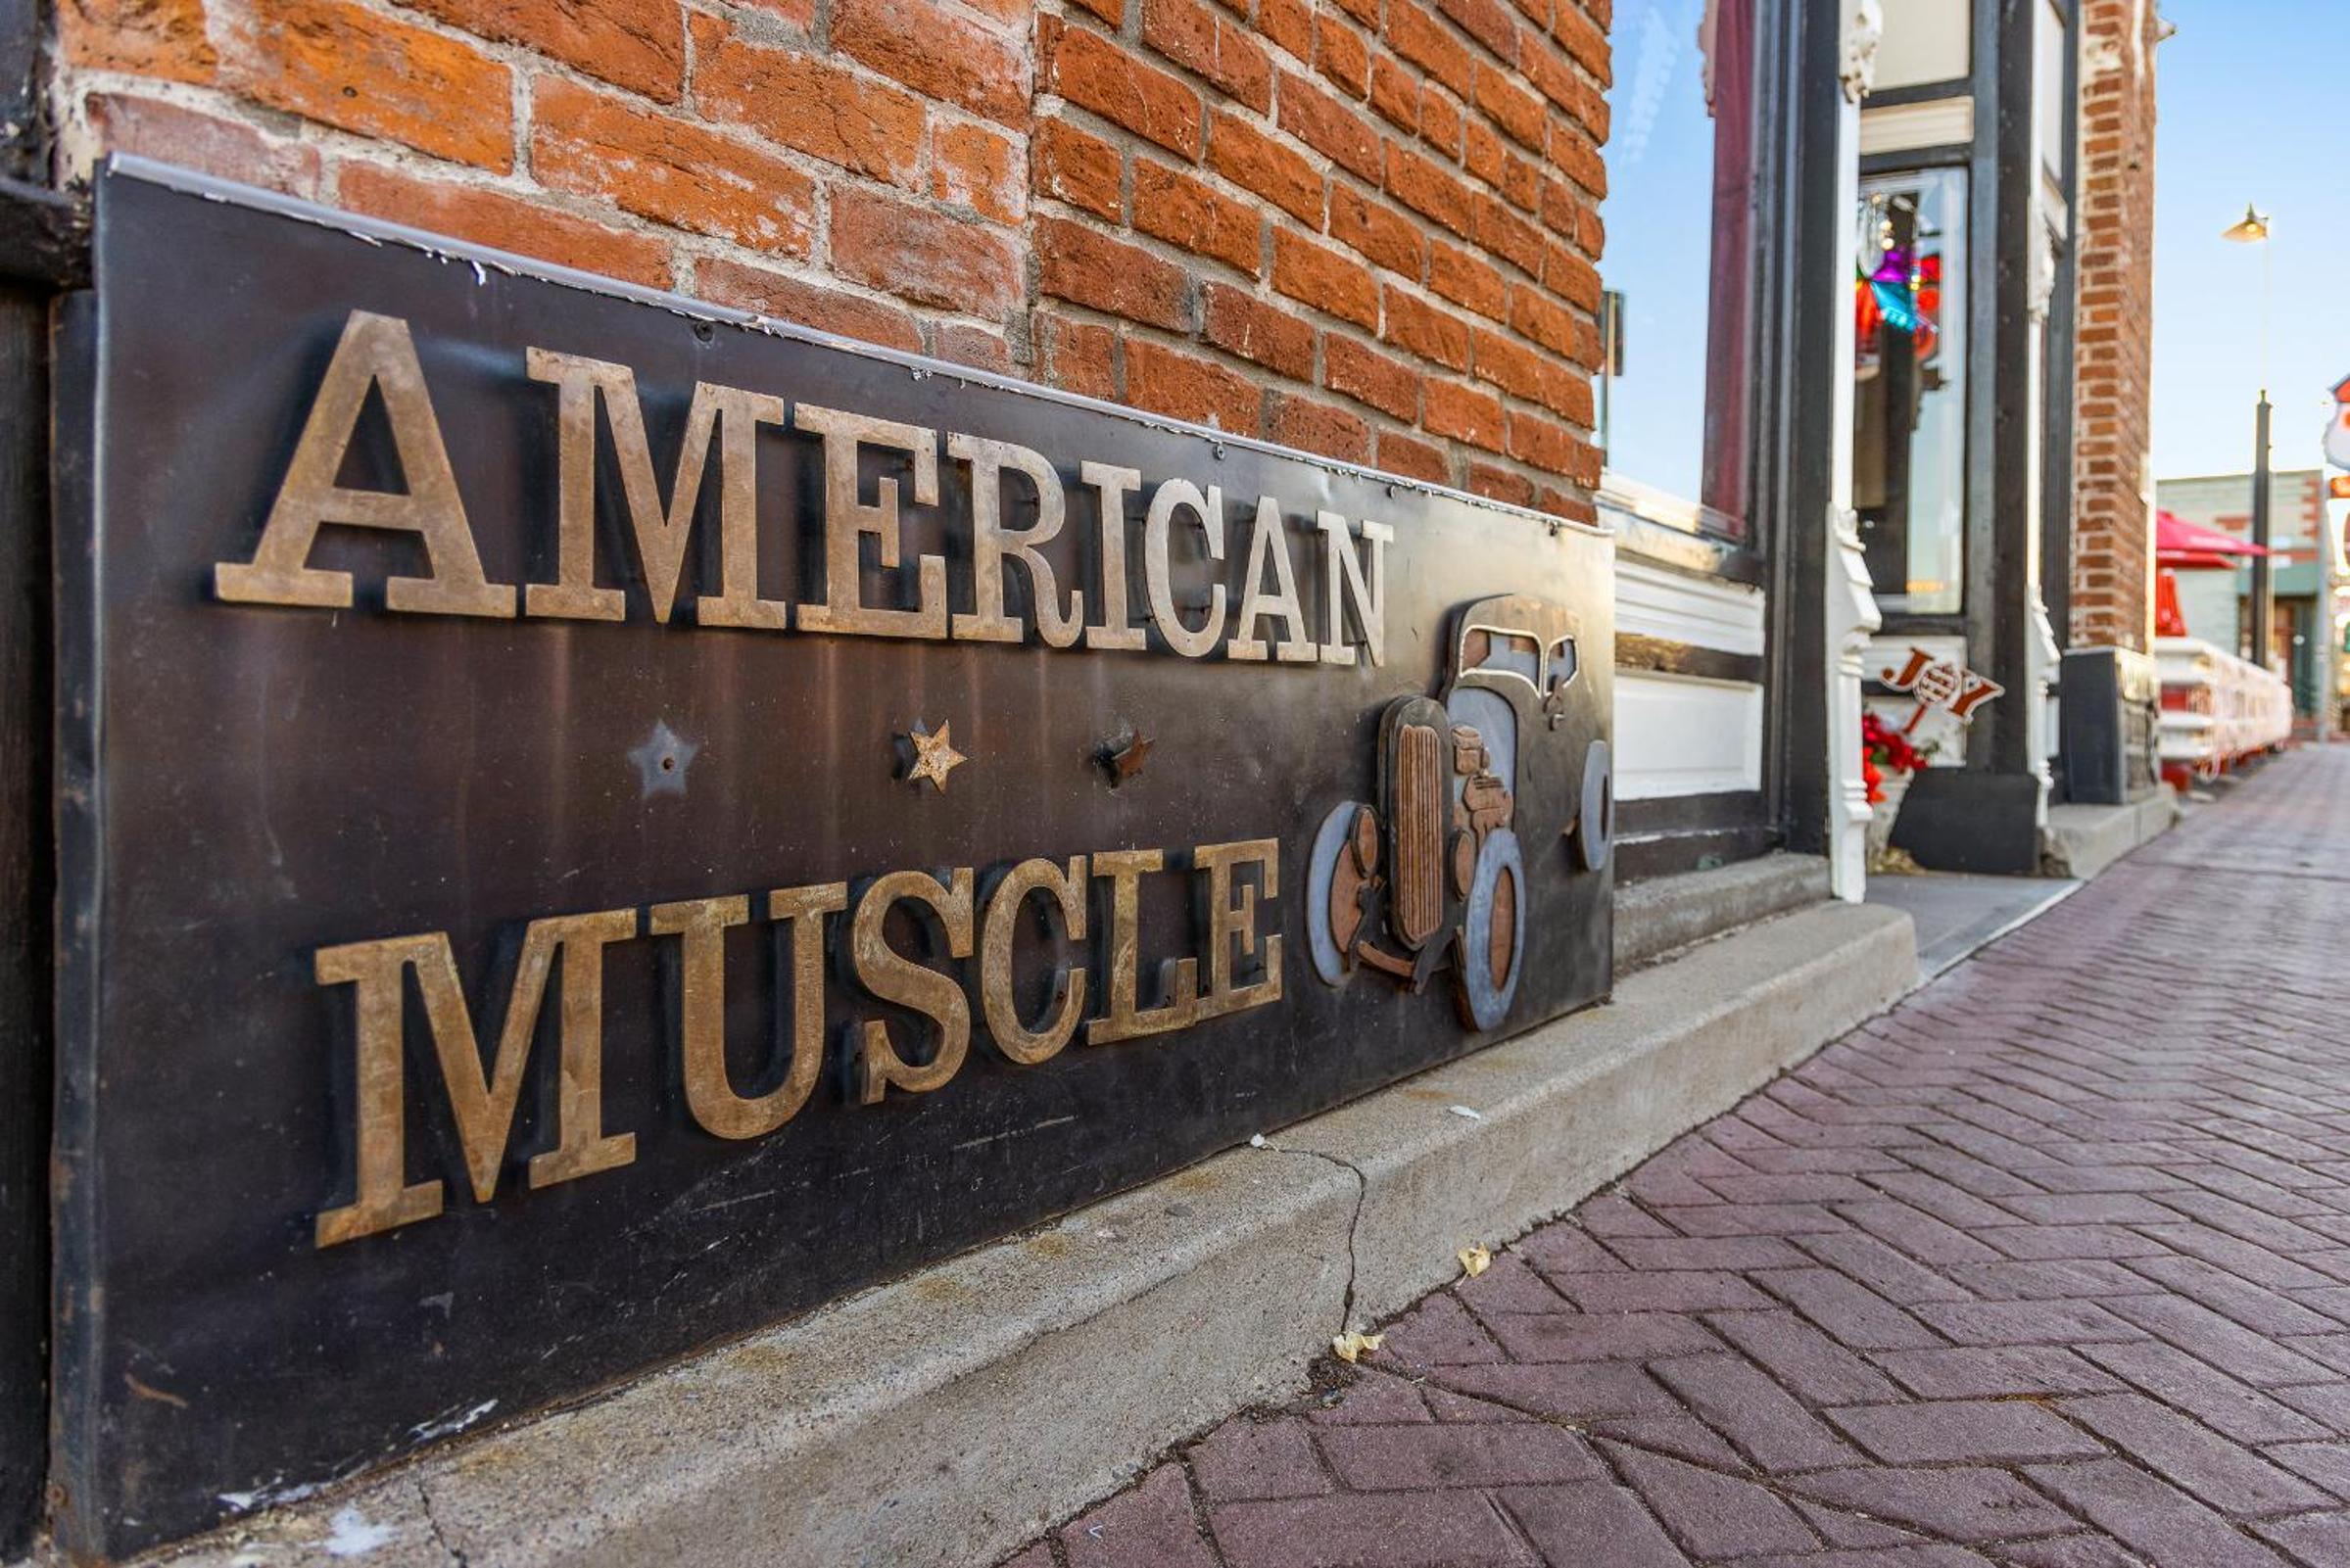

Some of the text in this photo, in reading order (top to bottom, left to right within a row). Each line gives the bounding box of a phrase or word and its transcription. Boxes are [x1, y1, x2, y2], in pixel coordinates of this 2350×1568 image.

[215, 309, 1394, 667] AMERICAN
[1881, 646, 1999, 718] JOY
[315, 838, 1282, 1249] MUSCLE
